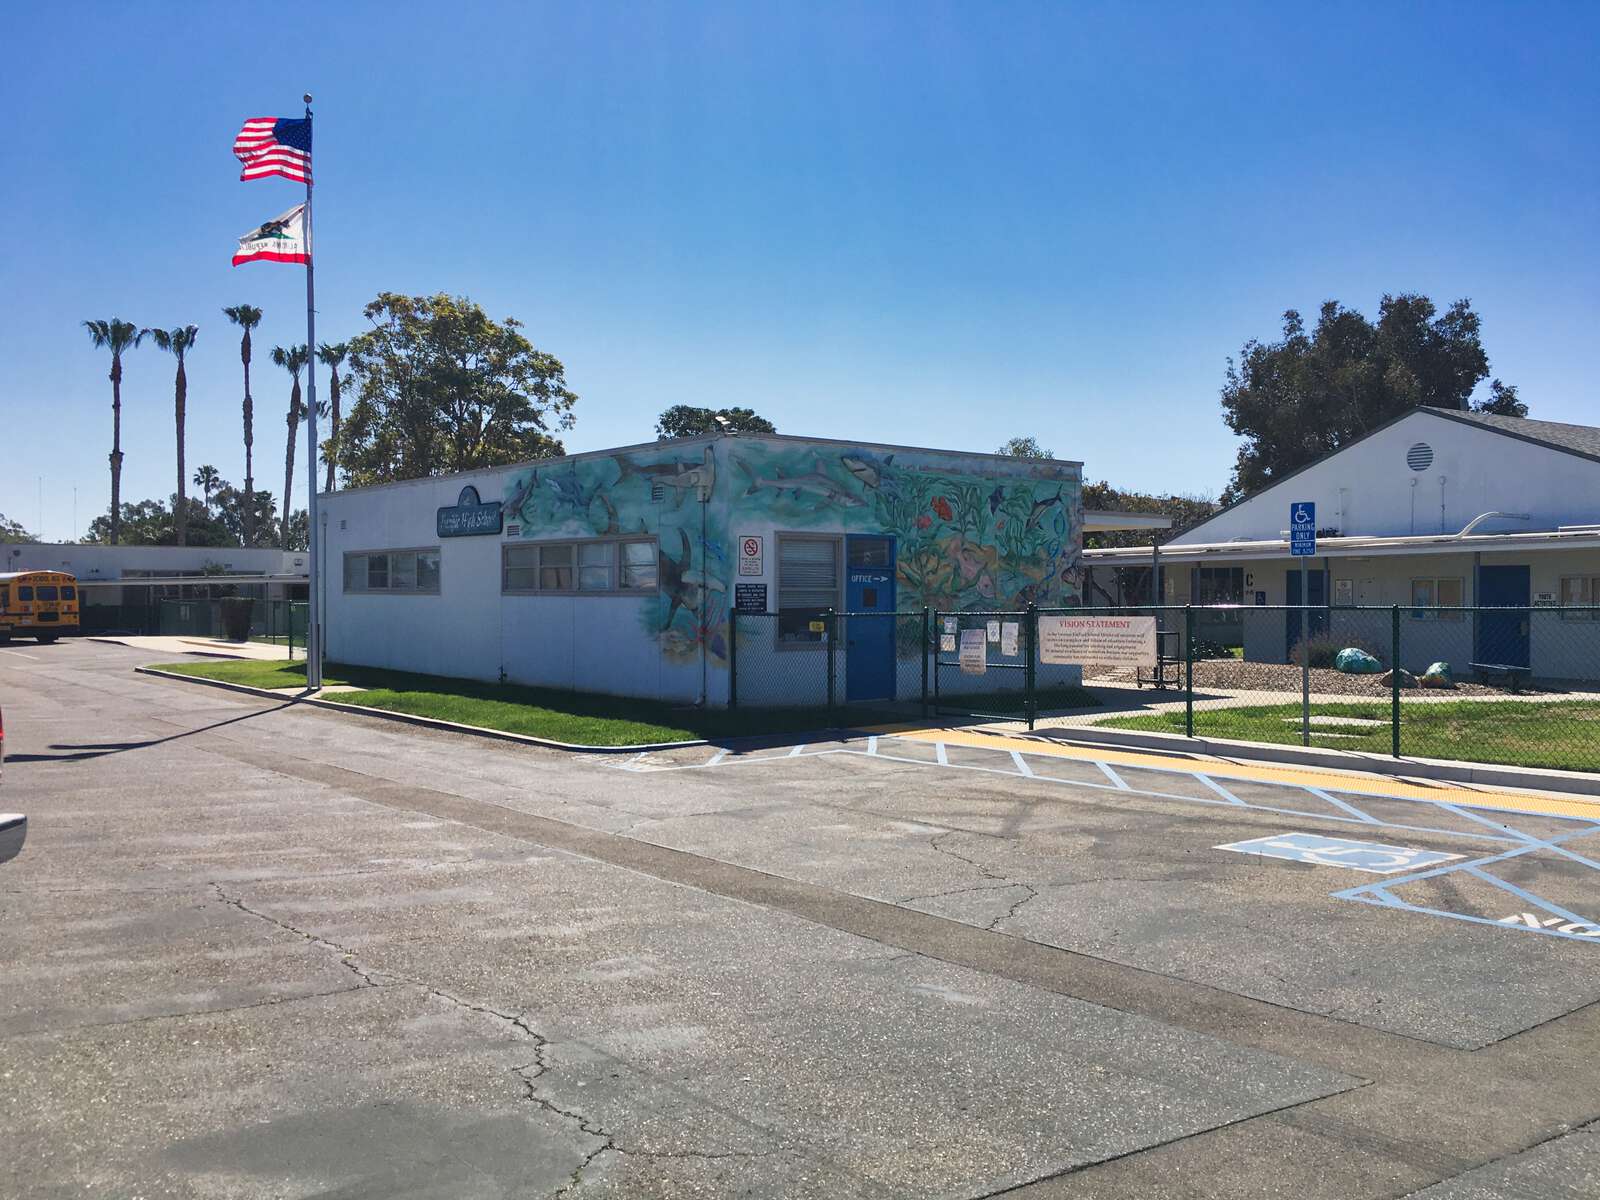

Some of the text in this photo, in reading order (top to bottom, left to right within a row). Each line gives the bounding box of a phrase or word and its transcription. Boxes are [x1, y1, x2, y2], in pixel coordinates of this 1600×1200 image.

[1292, 523, 1314, 531] PARKING
[1296, 532, 1310, 540] ONLY
[851, 574, 872, 583] OFFICE
[1059, 620, 1131, 629] VISION STATEMENT
